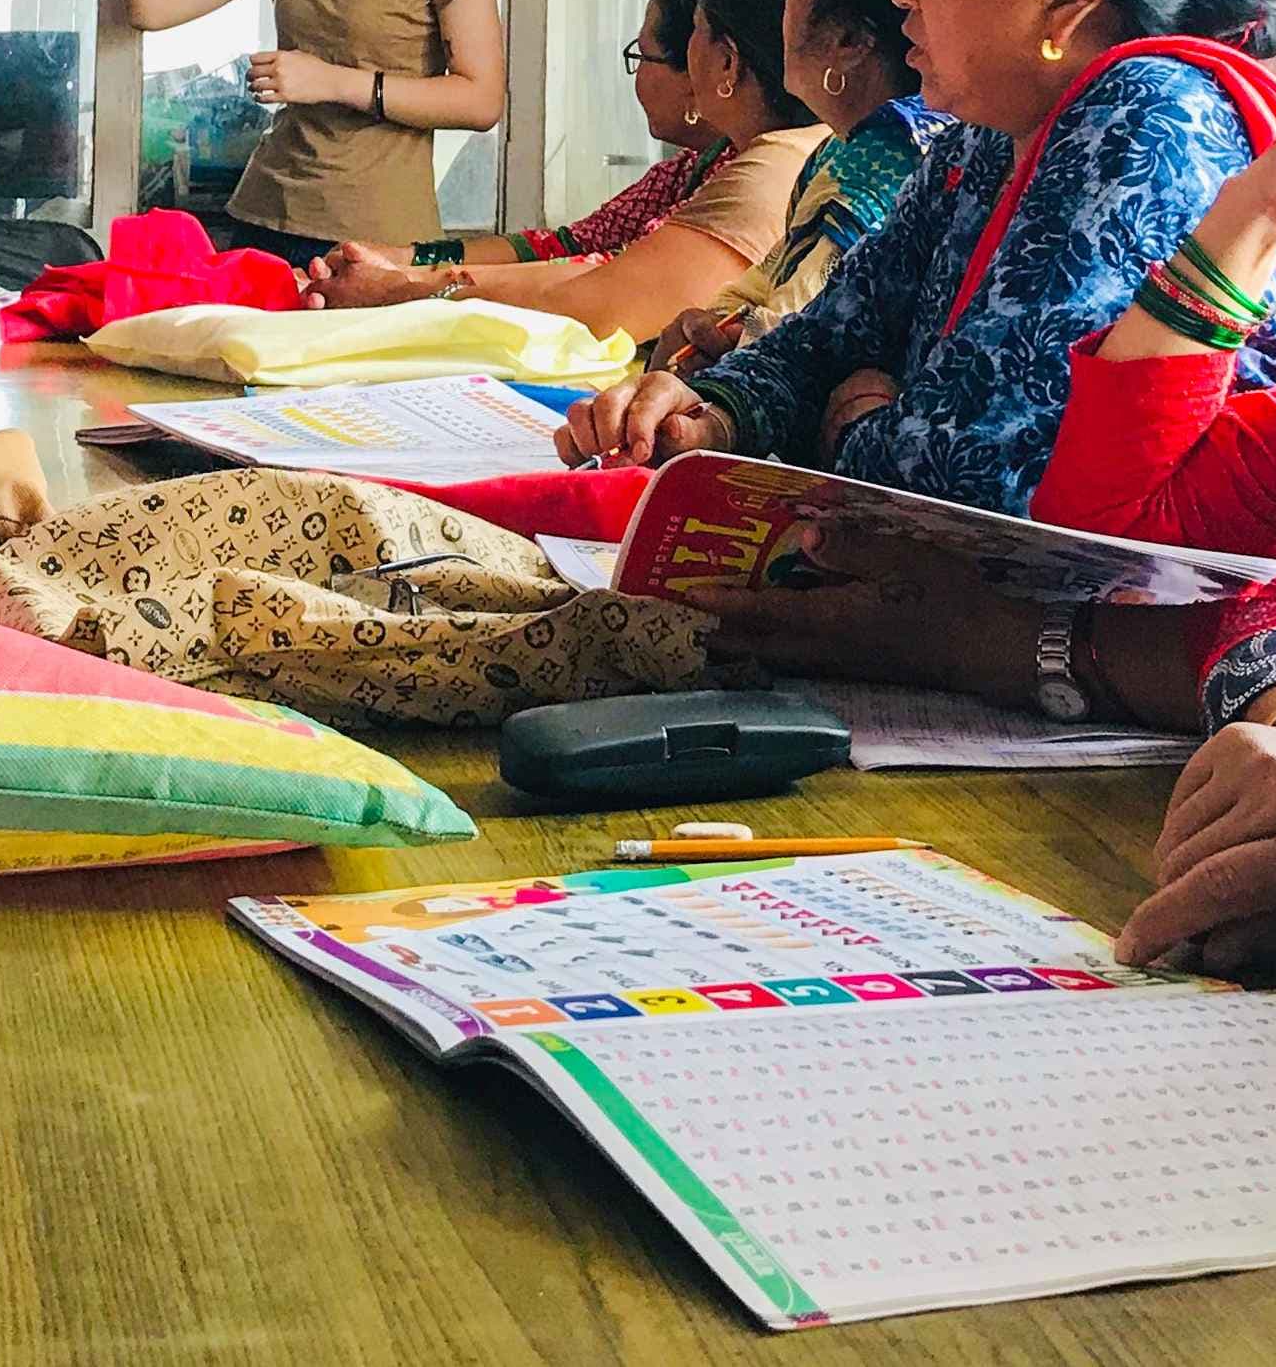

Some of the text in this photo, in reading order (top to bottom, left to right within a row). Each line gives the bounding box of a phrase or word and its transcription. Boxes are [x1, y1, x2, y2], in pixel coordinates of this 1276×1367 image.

[647, 514, 682, 587] BROTHER
[847, 979, 897, 993] 6
[913, 977, 967, 990] 7
[983, 973, 1032, 986] 8
[1047, 974, 1096, 987] 9
[706, 988, 753, 1003] 4
[777, 984, 831, 998] 5
[564, 999, 619, 1014] 2
[639, 994, 687, 1007] 3
[490, 1005, 540, 1018] 1
